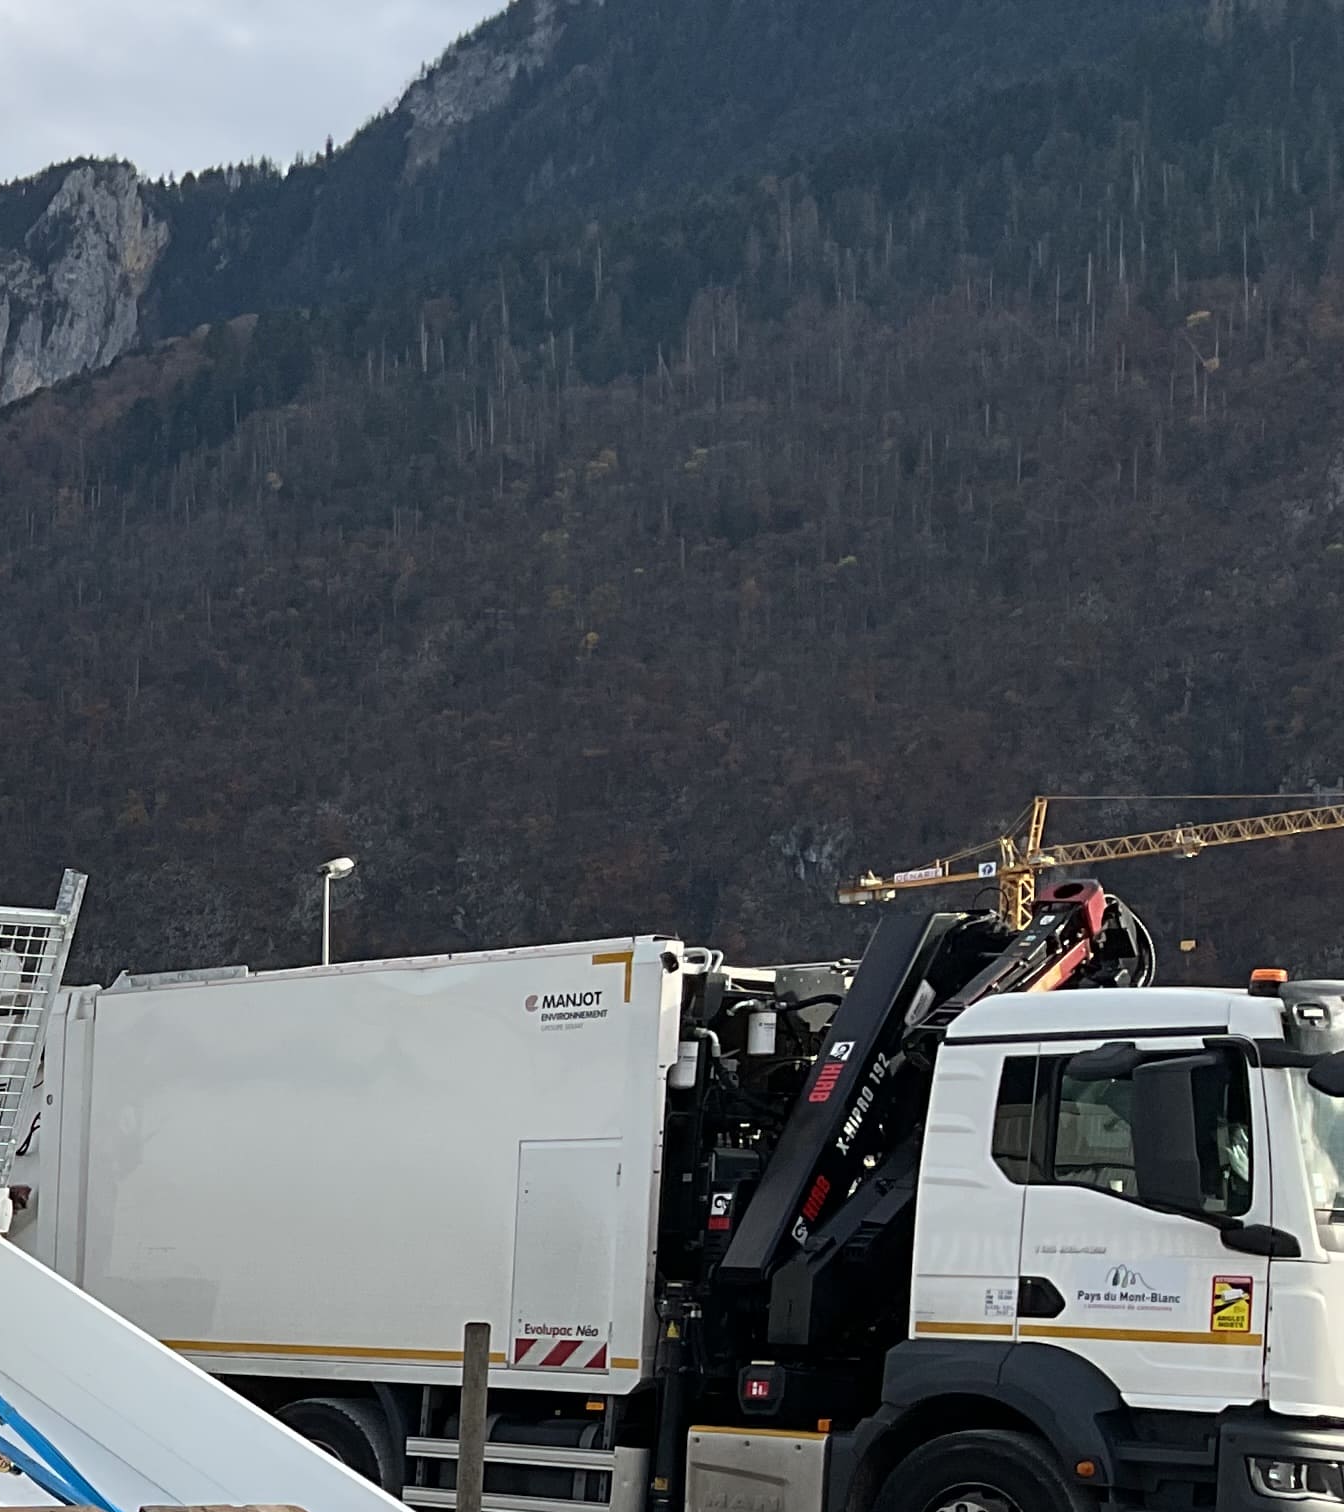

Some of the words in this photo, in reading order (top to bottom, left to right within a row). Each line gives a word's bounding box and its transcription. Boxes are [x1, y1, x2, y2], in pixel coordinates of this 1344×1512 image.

[542, 991, 603, 1009] MANJOT
[541, 1009, 608, 1022] ENVIRONNEMENT
[809, 1062, 845, 1102] HIAB
[835, 1085, 875, 1156] X-HIPRO
[869, 1052, 890, 1084] 192
[802, 1175, 831, 1221] HIAB
[1077, 1290, 1102, 1303] Pays
[1103, 1291, 1117, 1302] du
[1119, 1292, 1181, 1304] Mont-Blanc
[524, 1323, 573, 1338] Evolupac
